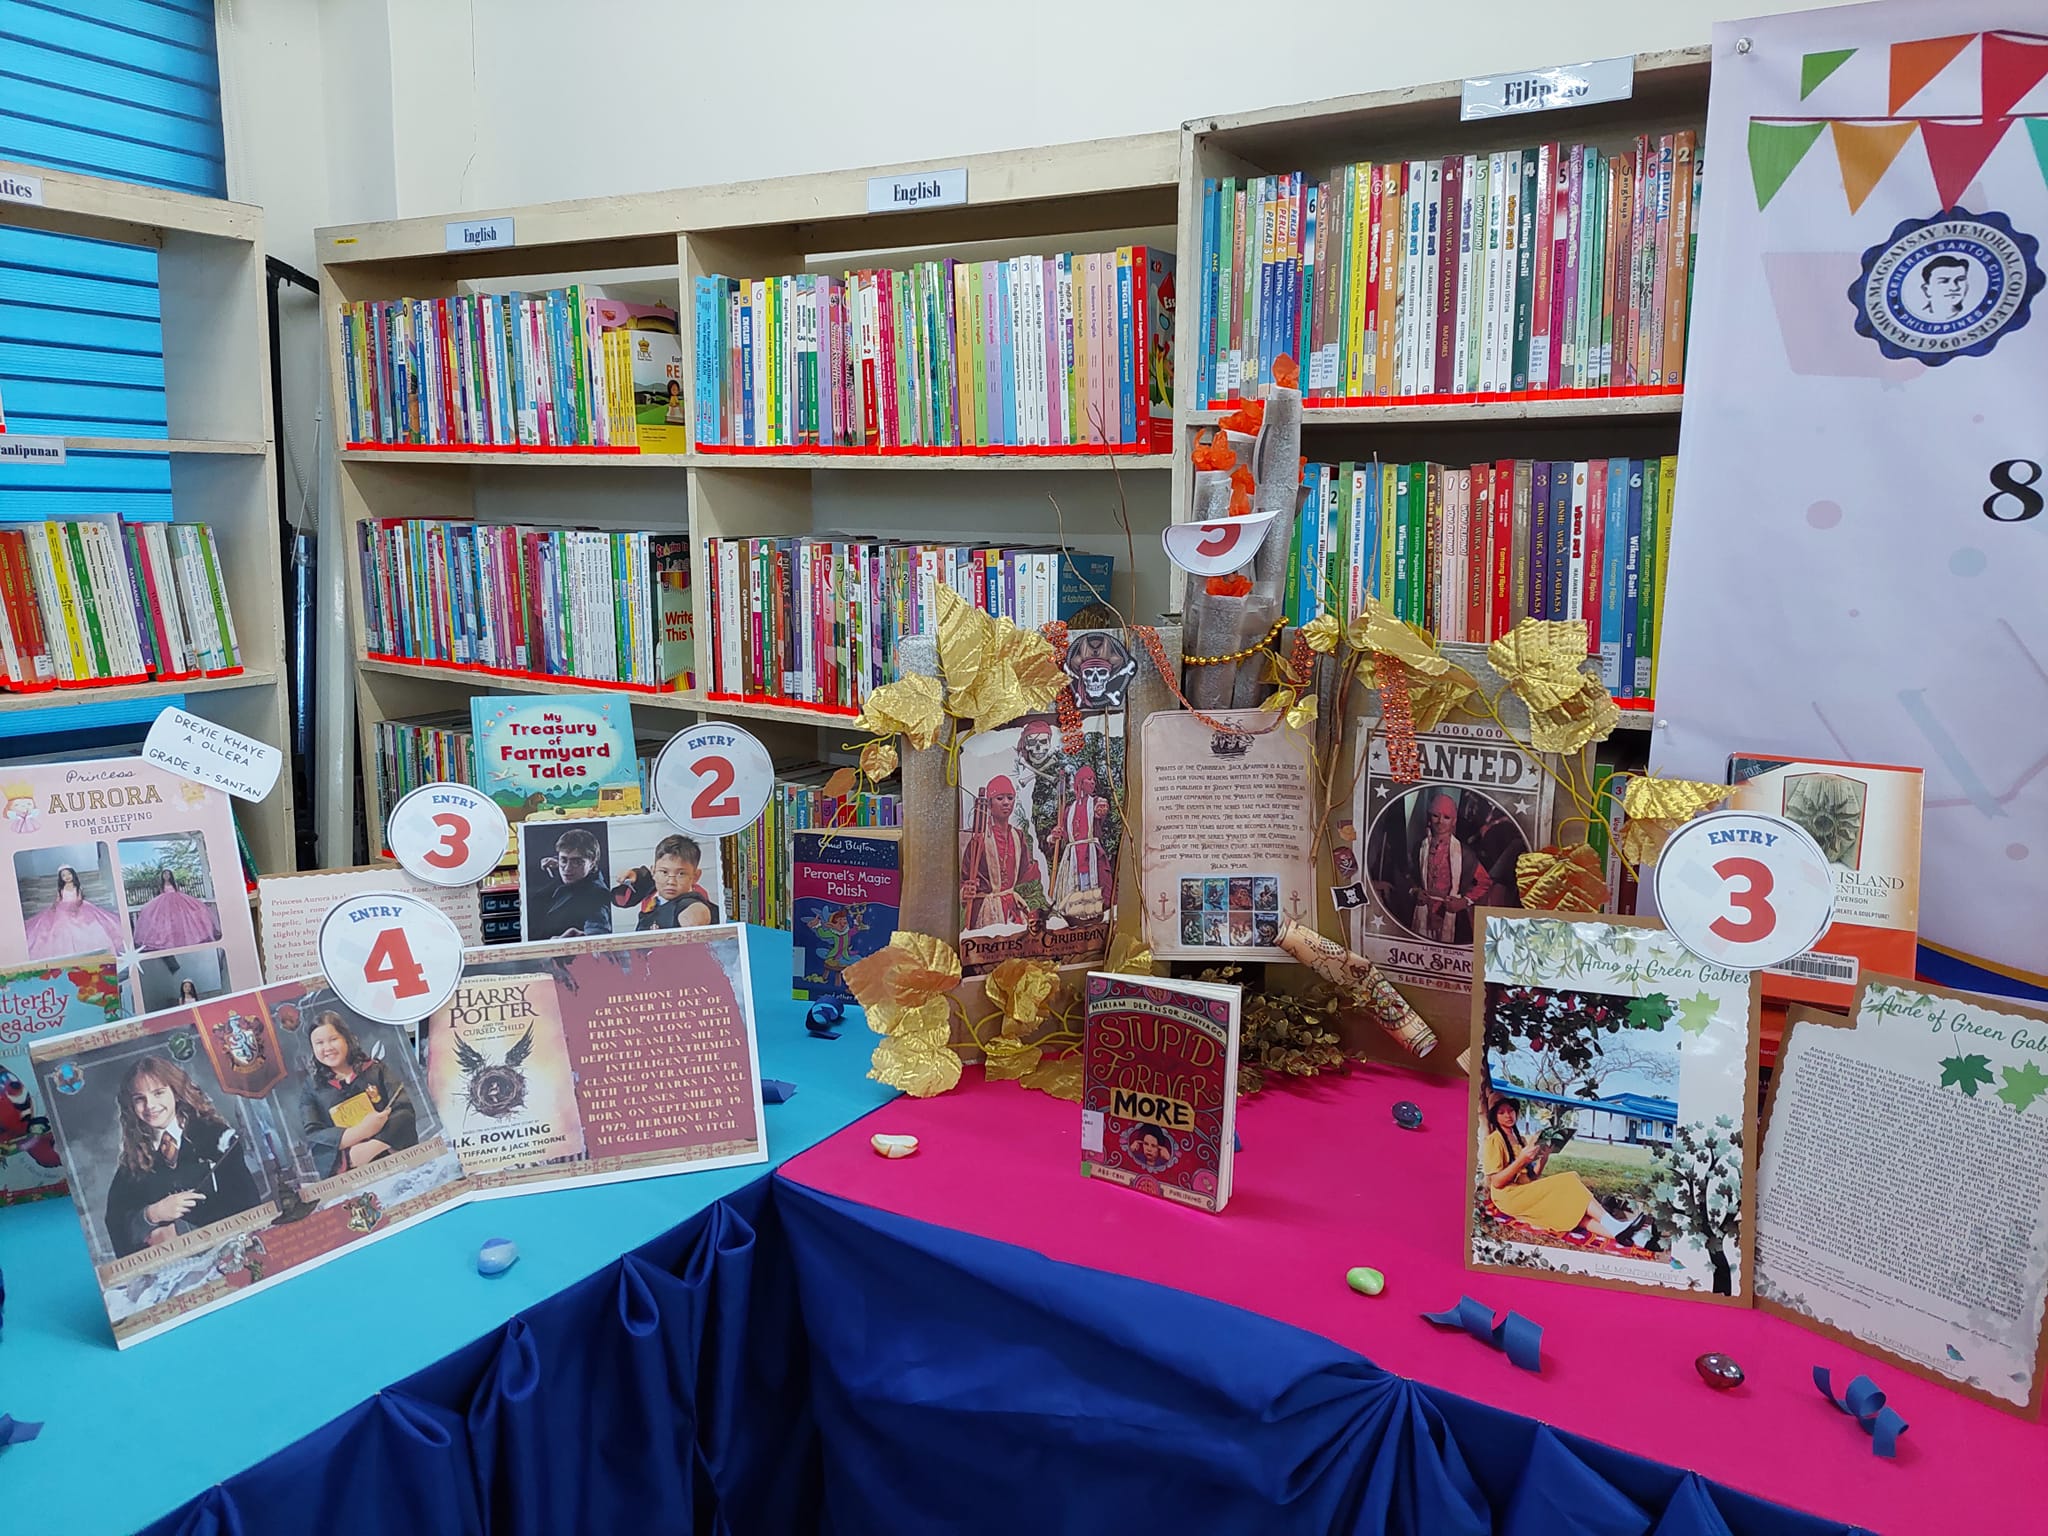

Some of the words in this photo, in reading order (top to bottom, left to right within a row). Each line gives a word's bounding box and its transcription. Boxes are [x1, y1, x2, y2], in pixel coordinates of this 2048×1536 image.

[1680, 151, 1689, 162] 2
[1414, 170, 1421, 181] 4
[1432, 170, 1438, 182] 2
[1477, 166, 1486, 179] 5
[1524, 162, 1535, 177] 4
[1560, 169, 1566, 183] 5
[1649, 164, 1655, 178] 6
[1696, 161, 1703, 175] 2
[894, 180, 941, 205] English
[1386, 182, 1396, 193] 2
[1309, 199, 1315, 213] 6
[1265, 211, 1274, 244] PERLAS
[1278, 208, 1286, 242] PERLAS
[464, 226, 497, 246] English
[1941, 224, 2021, 269] MEMORIAL
[1058, 261, 1064, 269] 6
[1868, 226, 1937, 297] MAGSAYSAY
[1889, 248, 1931, 298] GENERAL
[1937, 242, 1991, 265] SANTOS
[1989, 264, 2000, 292] CITY
[1966, 271, 2025, 342] COLLEGES
[1869, 297, 1910, 345] RAMON
[1899, 310, 1984, 332] PHILIPPINES
[1919, 336, 1961, 350] 1960
[666, 364, 683, 377] RE
[1, 444, 58, 458] anlipunan
[1398, 481, 1407, 495] 5
[1448, 478, 1454, 490] 1
[1461, 478, 1469, 490] 6
[1537, 475, 1547, 486] 3
[1558, 473, 1567, 484] 2
[1630, 474, 1641, 487] 6
[1983, 459, 2044, 522] 8
[1627, 536, 1639, 570] Wikang
[1628, 574, 1637, 598] Sarili
[666, 629, 687, 642] This
[543, 713, 562, 722] My
[174, 714, 219, 740] DREXIE
[223, 734, 266, 759] KHAYE
[509, 724, 596, 736] Treasury
[548, 736, 561, 745] of
[688, 736, 735, 750] ENTRY
[201, 741, 250, 766] OLLERA
[500, 743, 610, 762] Farmyard
[148, 748, 191, 771] GRADE
[193, 766, 201, 775] 3
[214, 774, 262, 797] SANTAN
[528, 763, 586, 778] Tales
[1415, 744, 1524, 785] ANTED
[66, 769, 136, 783] Princess
[690, 756, 740, 818] 2
[48, 784, 163, 814] AURORA
[432, 795, 478, 810] ENTRY
[65, 817, 97, 830] FROM
[100, 811, 153, 825] SLEEPING
[90, 823, 132, 835] BEAUTY
[423, 813, 471, 868] 3
[1708, 829, 1778, 847] ENTRY
[803, 867, 855, 881] Peronel's
[858, 872, 892, 886] Magic
[1840, 872, 1904, 889] ISLAND
[827, 882, 867, 898] Polish
[1709, 857, 1776, 943] 3
[349, 906, 402, 923] ENTRY
[962, 939, 1022, 957] PIRATES
[1042, 929, 1105, 948] CARIBBEAN
[364, 927, 430, 1000] 4
[1388, 948, 1425, 966] JACK
[1625, 960, 1643, 981] of
[1646, 960, 1693, 978] Green
[1699, 965, 1749, 984] Gables
[0, 988, 69, 1019] tterfly
[455, 984, 530, 1007] HARRY
[608, 990, 673, 1004] HERMIONE
[679, 986, 709, 997] JEAN
[449, 1002, 540, 1028] POTTER
[595, 1002, 655, 1016] GRANGER
[678, 998, 700, 1007] ONE
[707, 996, 722, 1004] OF
[588, 1017, 632, 1029] HARRY
[640, 1010, 696, 1023] POTTER'S
[702, 1006, 730, 1016] BEST
[652, 1022, 692, 1033] ALONG
[698, 1017, 731, 1028] WITH
[1092, 1001, 1127, 1011] MIRIAM
[1133, 1001, 1180, 1017] DEFENSOR
[1181, 1012, 1223, 1038] SANTIAGO
[1880, 994, 1925, 1019] Anne
[1927, 1010, 1949, 1033] of
[1951, 1013, 2008, 1042] Green
[463, 1027, 496, 1036] CURSED
[498, 1024, 525, 1032] CHILD
[592, 1041, 618, 1051] RON
[691, 1030, 713, 1039] SHE
[1100, 1015, 1216, 1067] STUPID
[581, 1050, 641, 1064] DEPICTED
[669, 1038, 742, 1054] EXTREMELY
[583, 1087, 617, 1098] WITH
[624, 1084, 648, 1093] TOP
[654, 1077, 698, 1089] MARKS
[703, 1076, 715, 1084] IN
[723, 1072, 746, 1082] ALL
[584, 1073, 635, 1086] CLASSIC
[1093, 1048, 1222, 1106] FOREVER
[591, 1100, 616, 1110] HER
[684, 1088, 706, 1098] SHE
[713, 1084, 740, 1094] WAS
[589, 1110, 622, 1122] BORN
[629, 1108, 646, 1117] ON
[652, 1097, 723, 1114] SEPTEMBER
[1113, 1090, 1190, 1126] MORE
[636, 1114, 702, 1128] HERMIONE
[480, 1124, 550, 1144] ROWLING
[597, 1126, 688, 1145] MUGGLE-BORN
[463, 1147, 498, 1158] TIFFANY
[510, 1141, 529, 1152] JACK
[532, 1135, 567, 1145] THORNE
